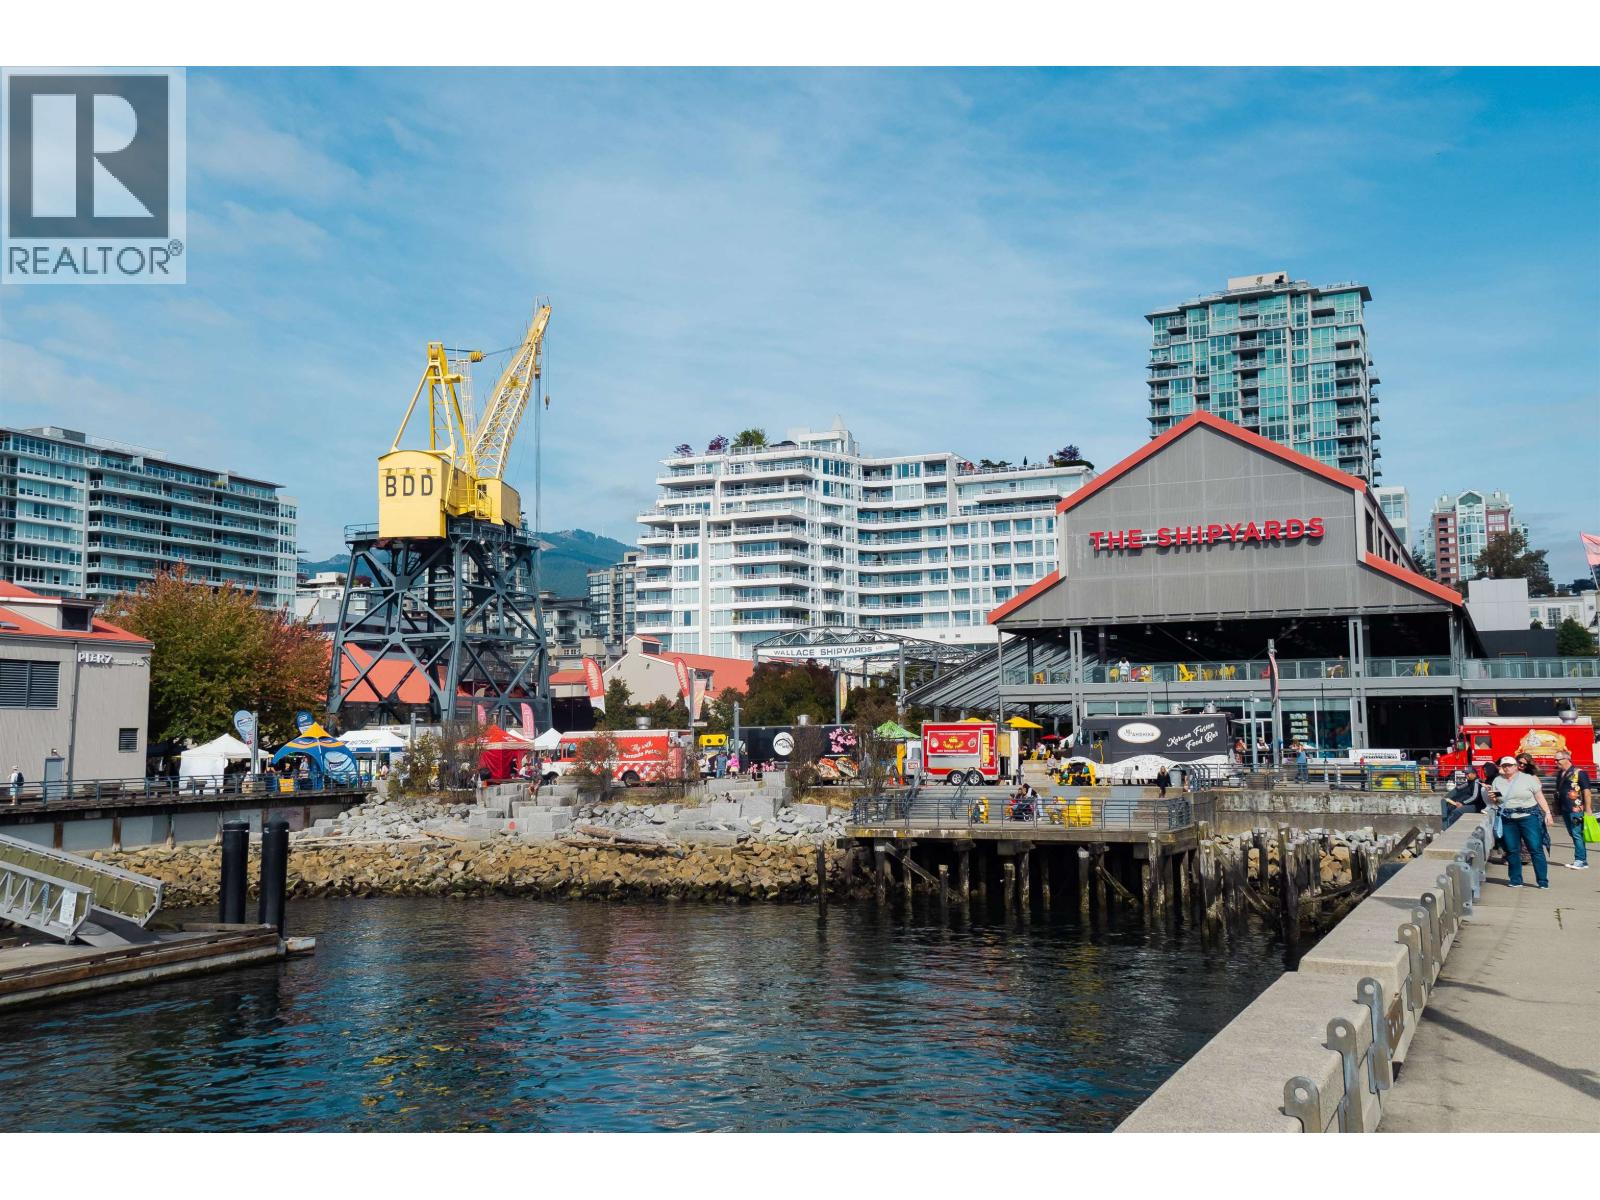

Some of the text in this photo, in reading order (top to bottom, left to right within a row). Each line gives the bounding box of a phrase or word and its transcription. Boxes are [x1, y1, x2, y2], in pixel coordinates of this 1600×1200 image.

[386, 475, 433, 496] BDD
[1089, 517, 1326, 551] THE SHIPYARDS
[773, 648, 815, 657] WALLACE
[820, 646, 873, 656] SHIPYARDS
[1166, 723, 1215, 747] Korean Fusion
[1185, 730, 1219, 751] Food Bar
